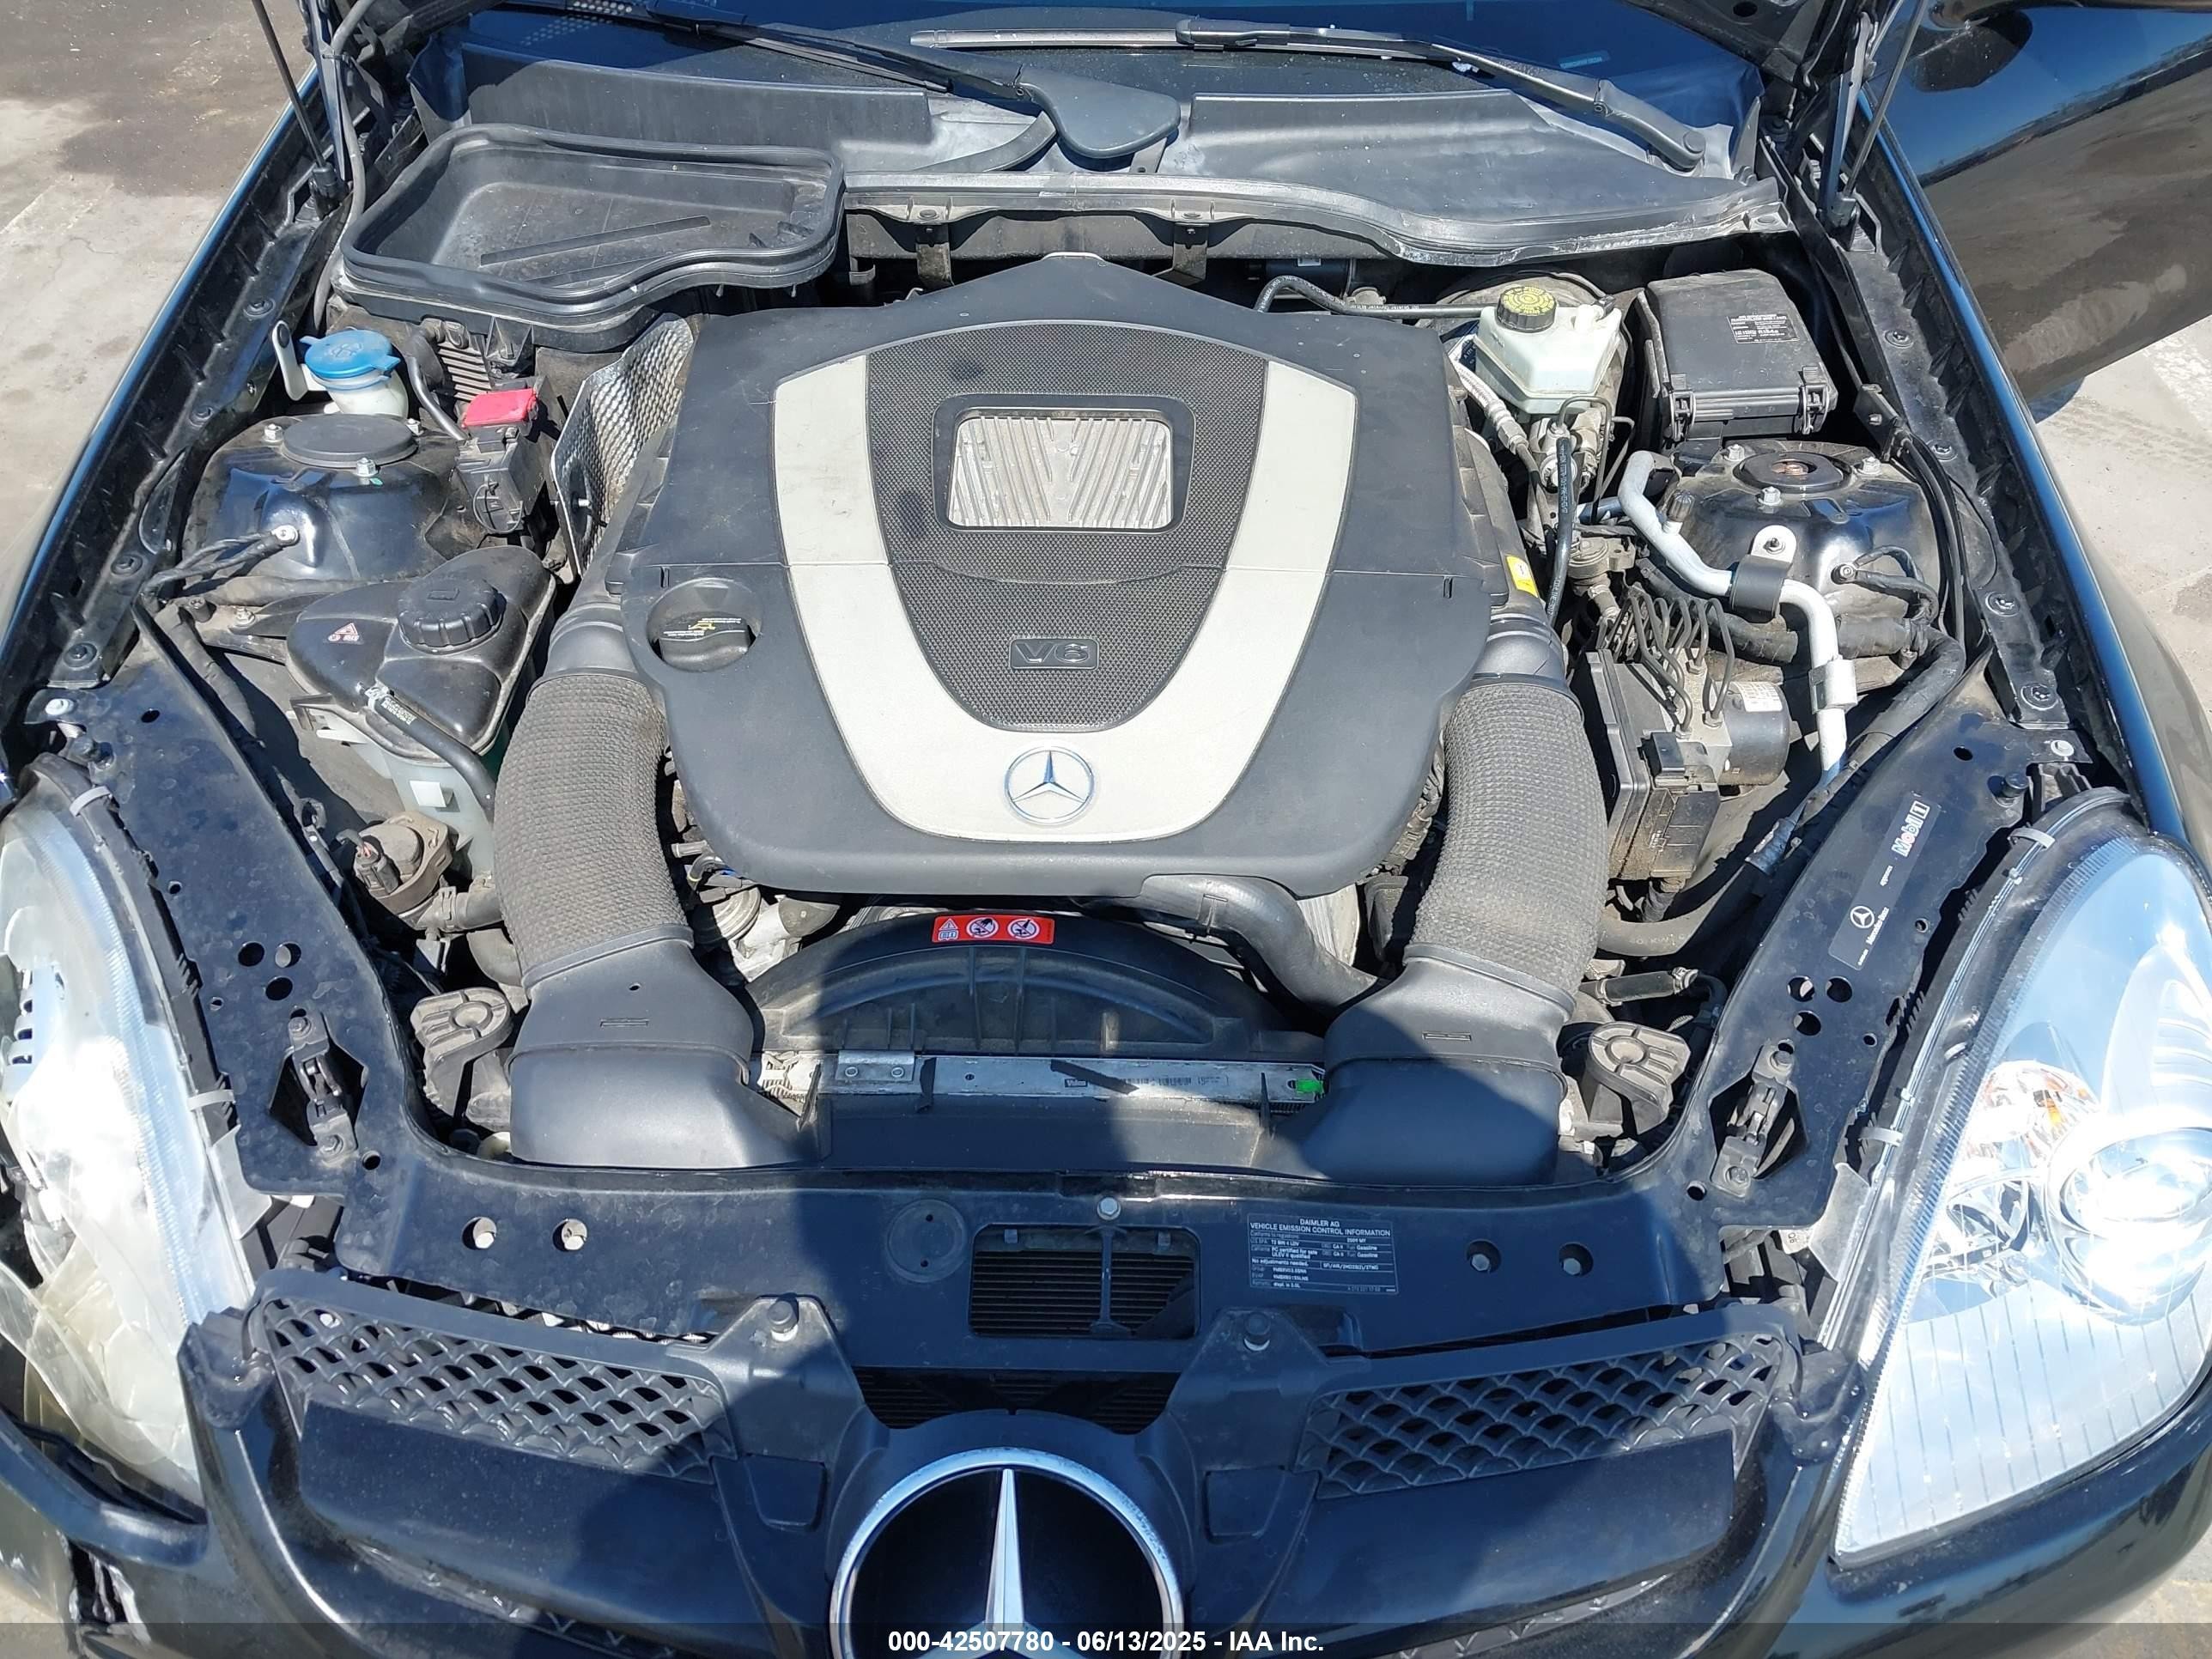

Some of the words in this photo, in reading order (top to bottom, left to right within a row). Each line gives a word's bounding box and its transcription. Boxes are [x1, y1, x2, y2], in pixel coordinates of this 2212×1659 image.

[1015, 641, 1091, 664] V6
[1866, 907, 1890, 945] Mercedes-Benz
[1892, 814, 1923, 857] Mobil
[1279, 1224, 1310, 1232] EMISSION
[1312, 1226, 1343, 1235] CONTROL
[1299, 1218, 1328, 1227] DAIMLER
